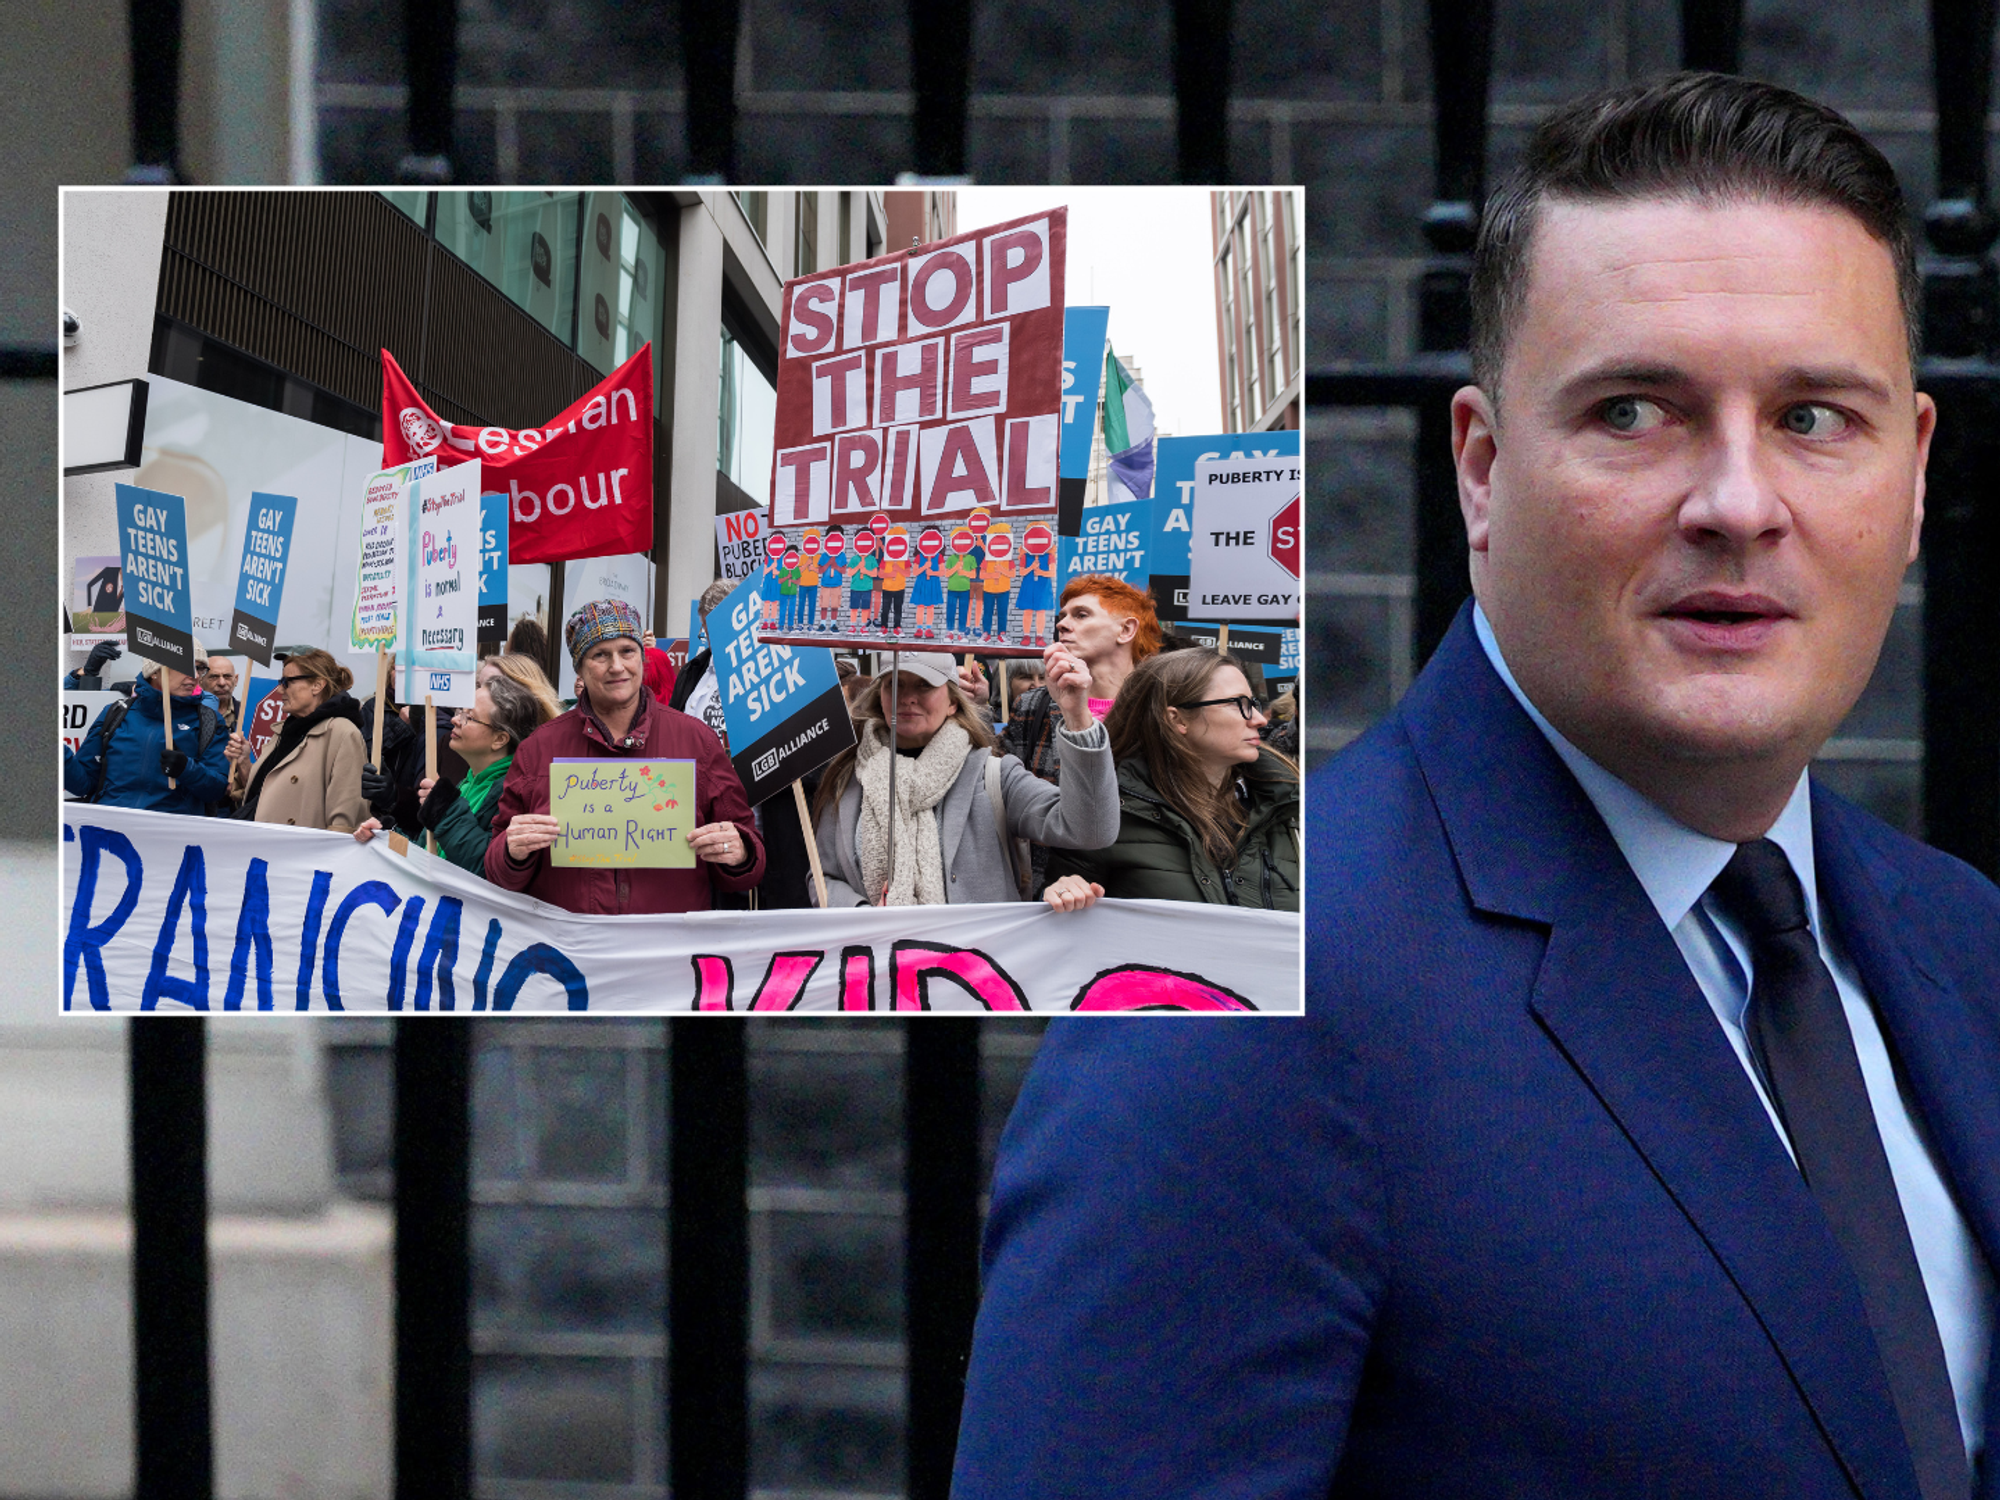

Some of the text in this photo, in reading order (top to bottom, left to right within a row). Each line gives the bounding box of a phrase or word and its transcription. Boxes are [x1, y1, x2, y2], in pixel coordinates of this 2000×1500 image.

[790, 230, 1044, 353] STOP
[815, 327, 1003, 429] THE
[780, 420, 1051, 521] TRIAL
[1208, 470, 1285, 485] PUBERTY
[133, 503, 167, 532] GAY
[258, 507, 283, 532] GAY
[725, 512, 759, 543] NO
[1086, 513, 1131, 534] GAY
[127, 527, 178, 562] TEENS
[250, 530, 284, 558] TEENS
[422, 529, 457, 569] Puberty
[1075, 531, 1140, 553] TEENS
[1210, 531, 1256, 547] THE
[126, 553, 183, 590] AREN'T
[243, 553, 283, 584] AREN'T
[1067, 550, 1145, 573] AREN’T
[138, 581, 175, 613] SICK
[246, 579, 272, 606] SICK
[425, 579, 432, 598] is
[1201, 594, 1253, 606] LEAVE
[1257, 594, 1293, 606] GAY
[193, 617, 225, 630] REET
[731, 590, 763, 631] GA
[153, 635, 184, 655] ALLIANCE
[422, 627, 464, 651] necessary
[725, 620, 764, 668] TEE
[430, 674, 450, 691] NHS
[728, 644, 793, 704] AREN
[747, 657, 806, 722] SICK
[755, 717, 830, 776] LGB ALLIANCE
[553, 821, 618, 849] Human
